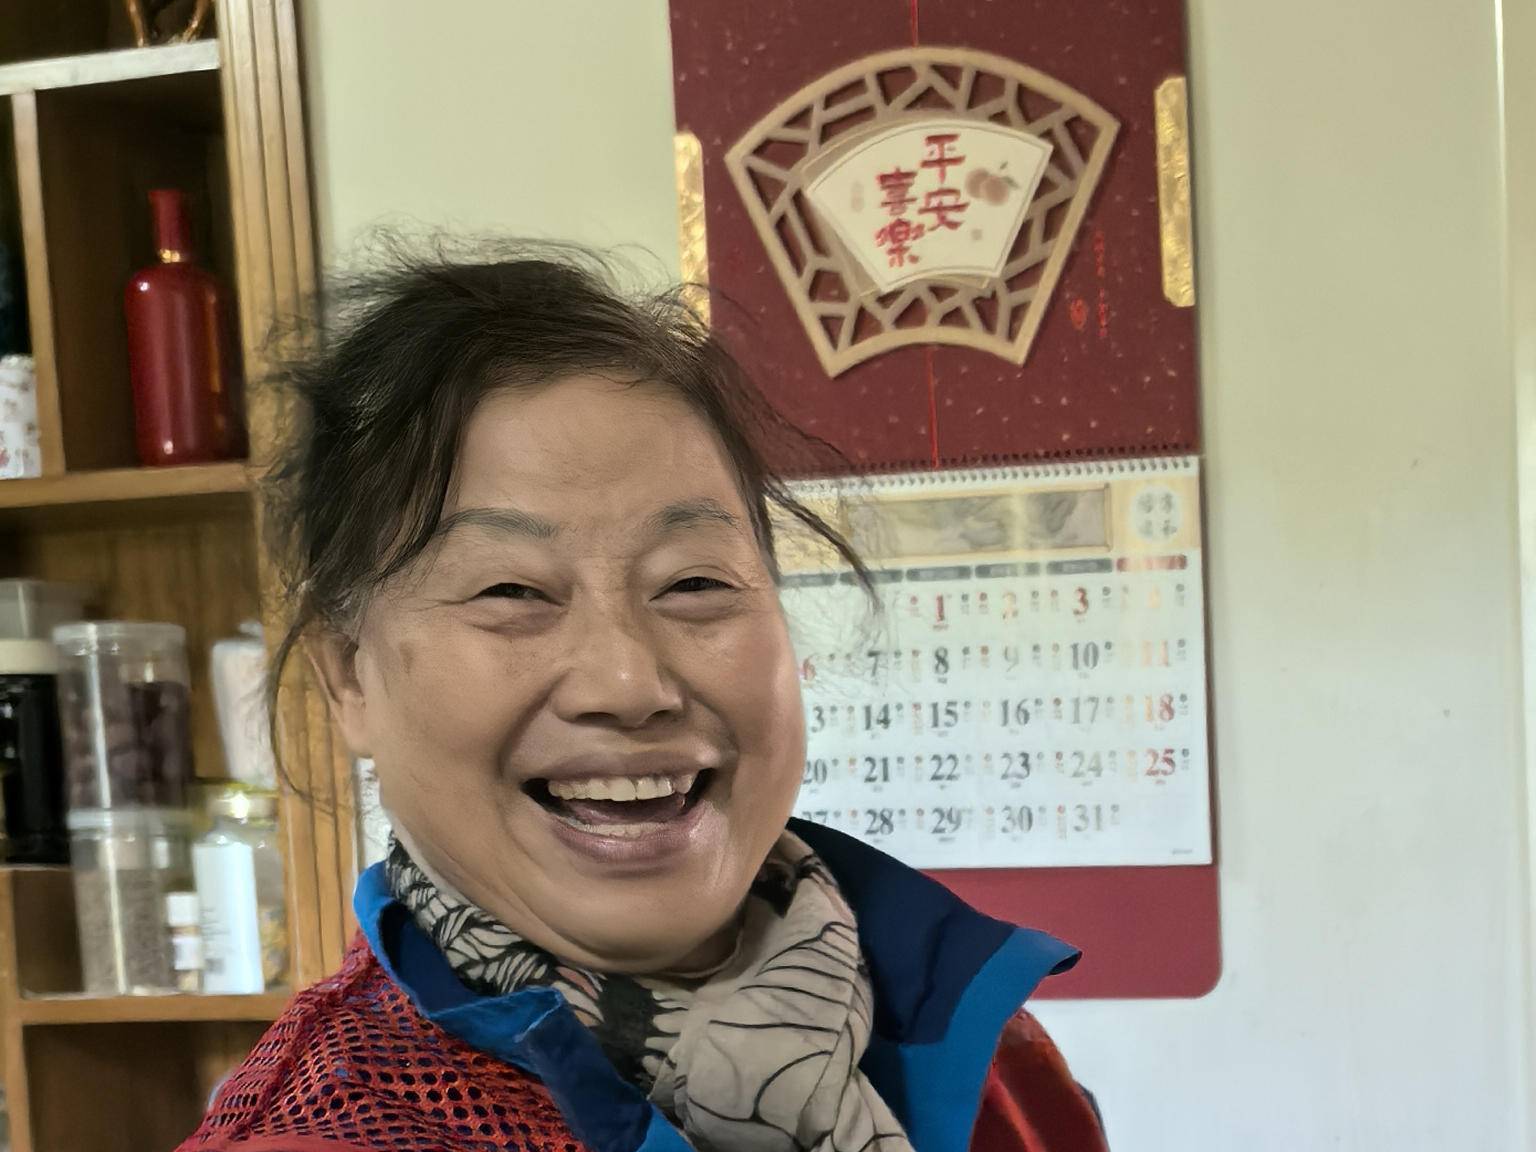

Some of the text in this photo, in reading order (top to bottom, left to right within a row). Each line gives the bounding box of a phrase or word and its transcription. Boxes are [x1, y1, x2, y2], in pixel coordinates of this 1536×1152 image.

[919, 133, 970, 232] 平安
[936, 594, 946, 622] 1
[1073, 586, 1089, 616] 3
[934, 646, 949, 675] 8
[1070, 642, 1099, 670] 10
[810, 693, 1175, 733] 3 14 15 16 17 18
[864, 756, 891, 783] 21
[930, 753, 960, 781] 22
[1001, 752, 1031, 780] 23
[1072, 750, 1103, 778] 24
[1145, 748, 1176, 776] 25
[865, 808, 894, 836] 28
[931, 807, 962, 835] 29
[1001, 805, 1034, 834] 30
[1073, 804, 1103, 832] 31
